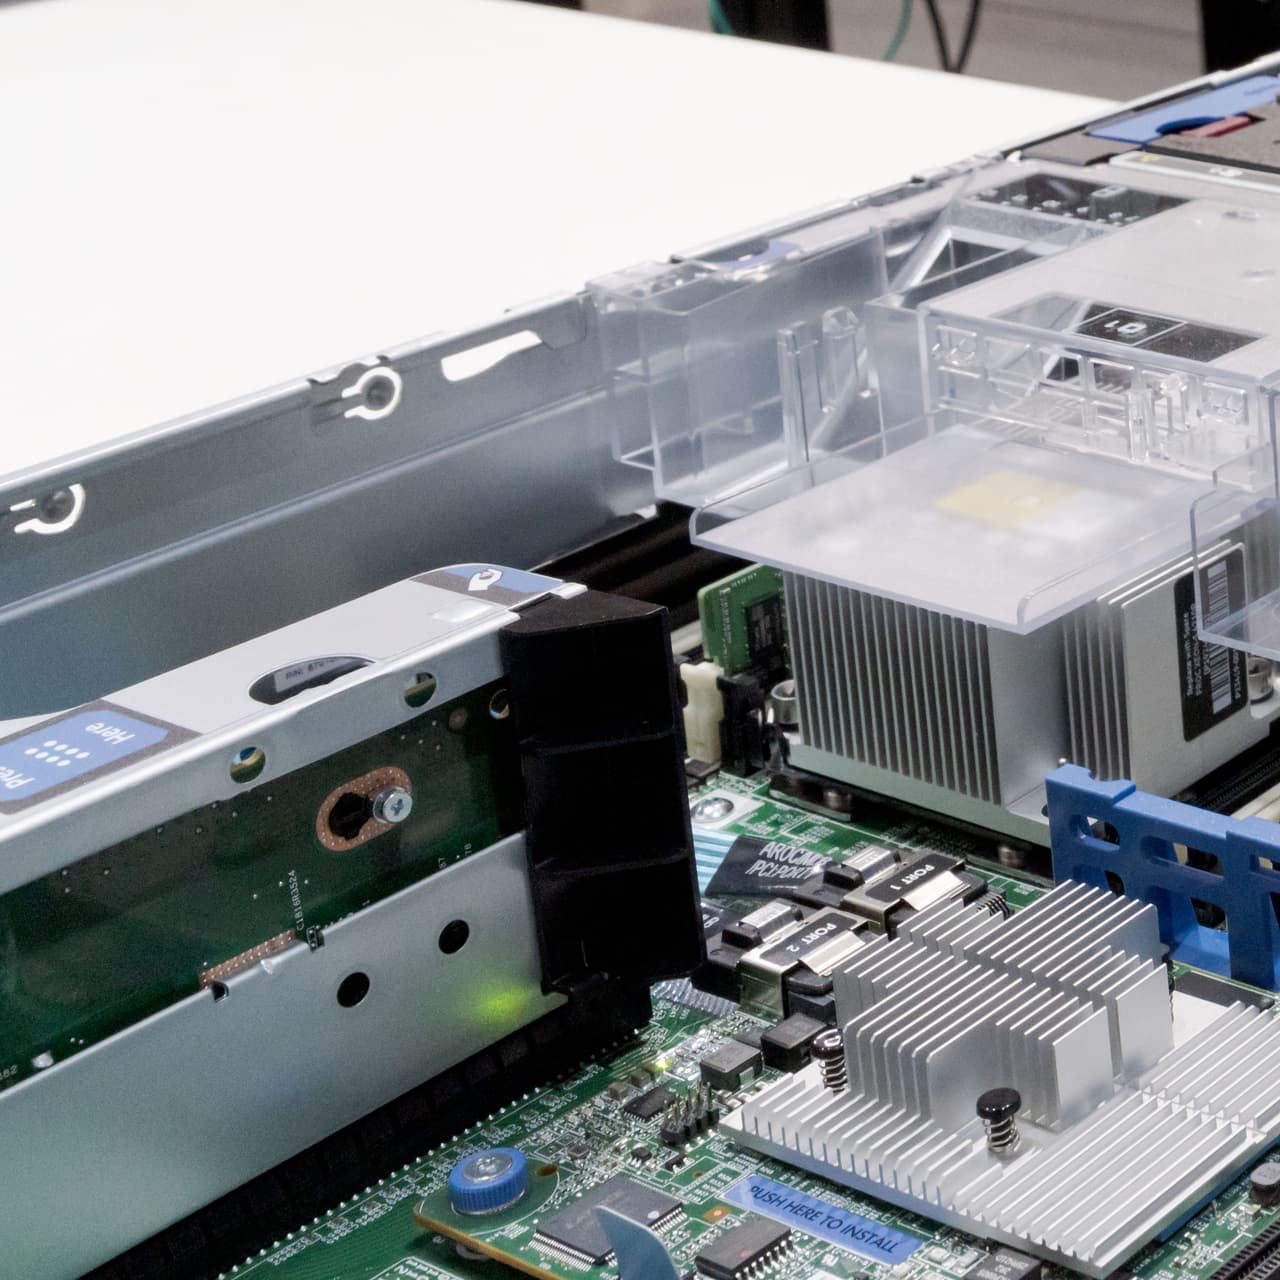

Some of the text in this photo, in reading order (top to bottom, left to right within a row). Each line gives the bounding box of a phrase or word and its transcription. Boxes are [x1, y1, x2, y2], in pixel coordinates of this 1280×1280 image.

[85, 722, 136, 745] Here
[901, 864, 935, 886] PORT
[785, 922, 838, 953] PORT 2
[750, 1184, 899, 1254] PUSH HERE TO INSTALL
